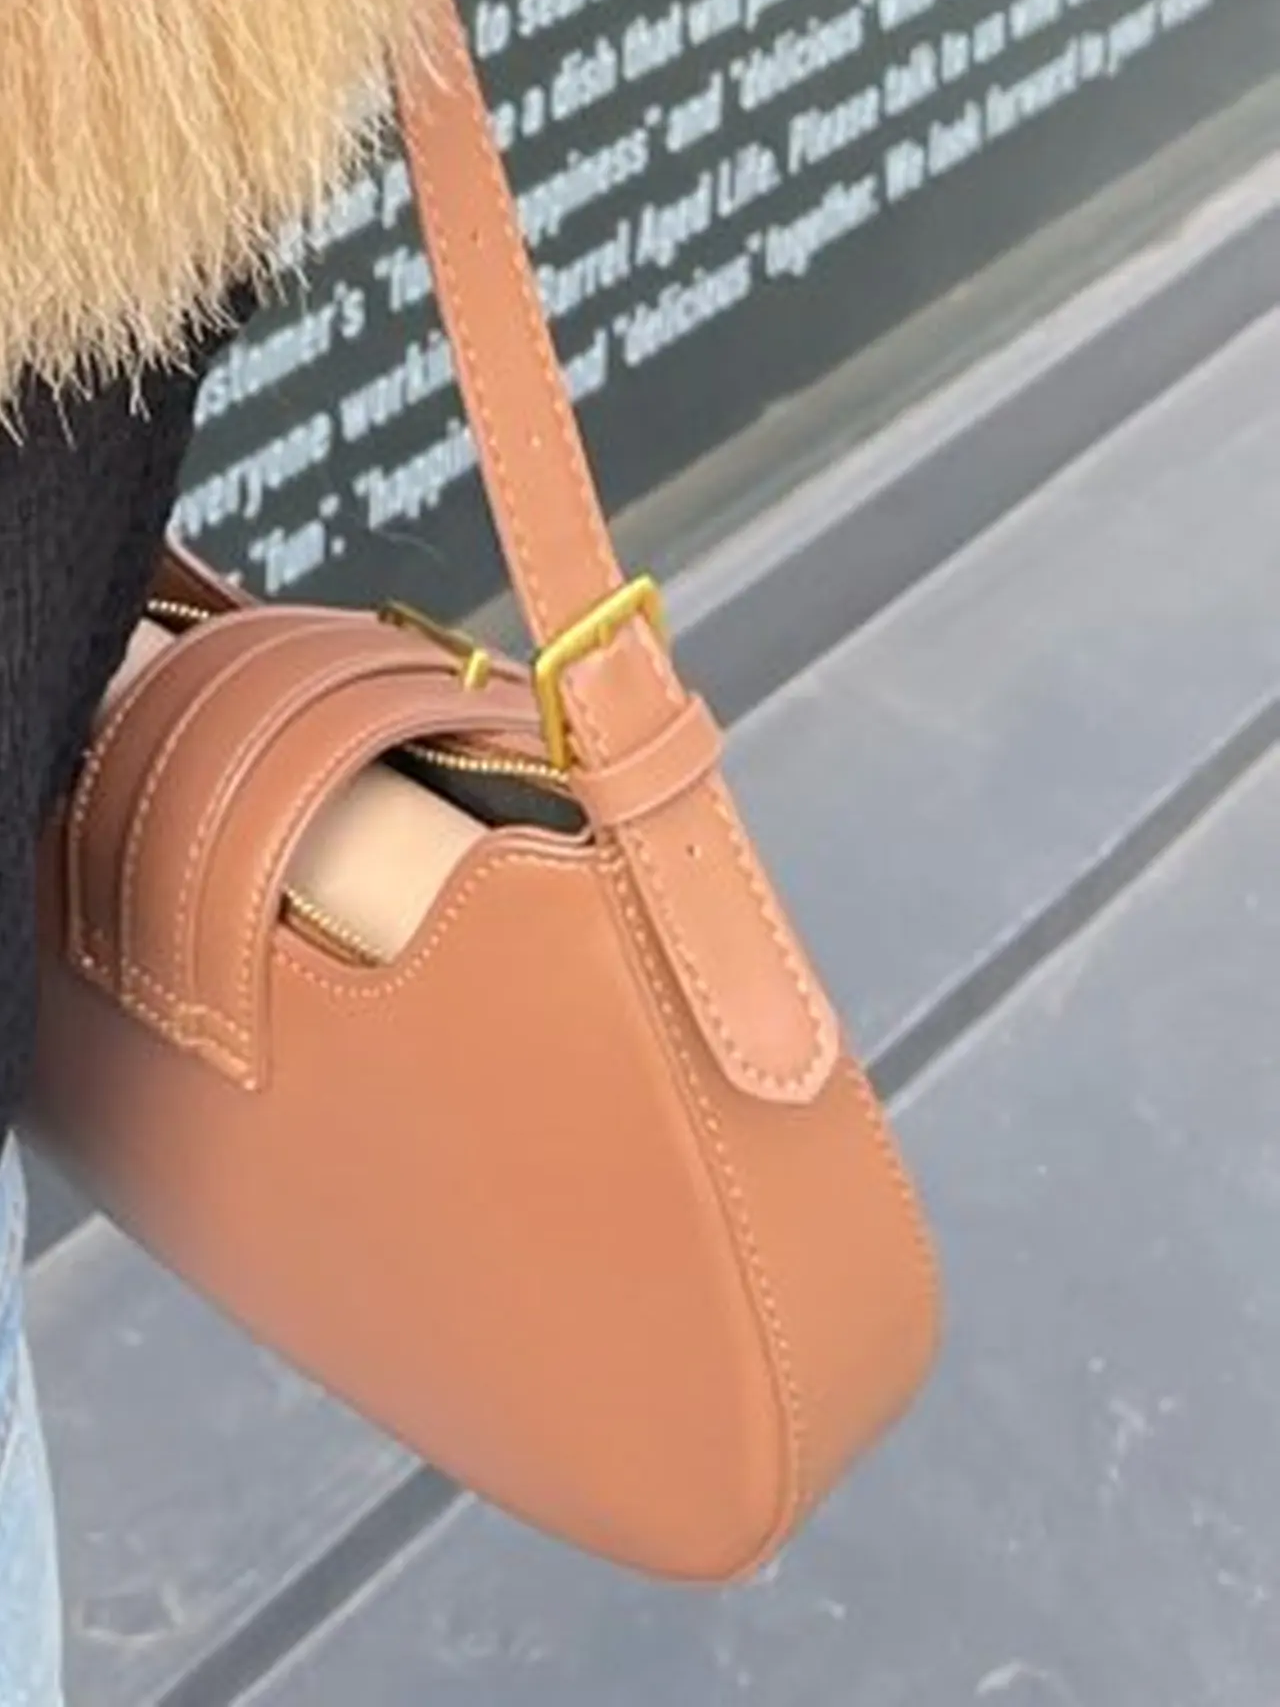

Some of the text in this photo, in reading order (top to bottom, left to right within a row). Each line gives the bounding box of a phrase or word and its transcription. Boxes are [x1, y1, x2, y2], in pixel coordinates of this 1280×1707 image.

[474, 0, 510, 58] to
[521, 86, 545, 135] a
[550, 36, 617, 120] dish
[621, 1, 684, 80] that
[665, 71, 723, 152] and
[634, 170, 713, 267] Aged
